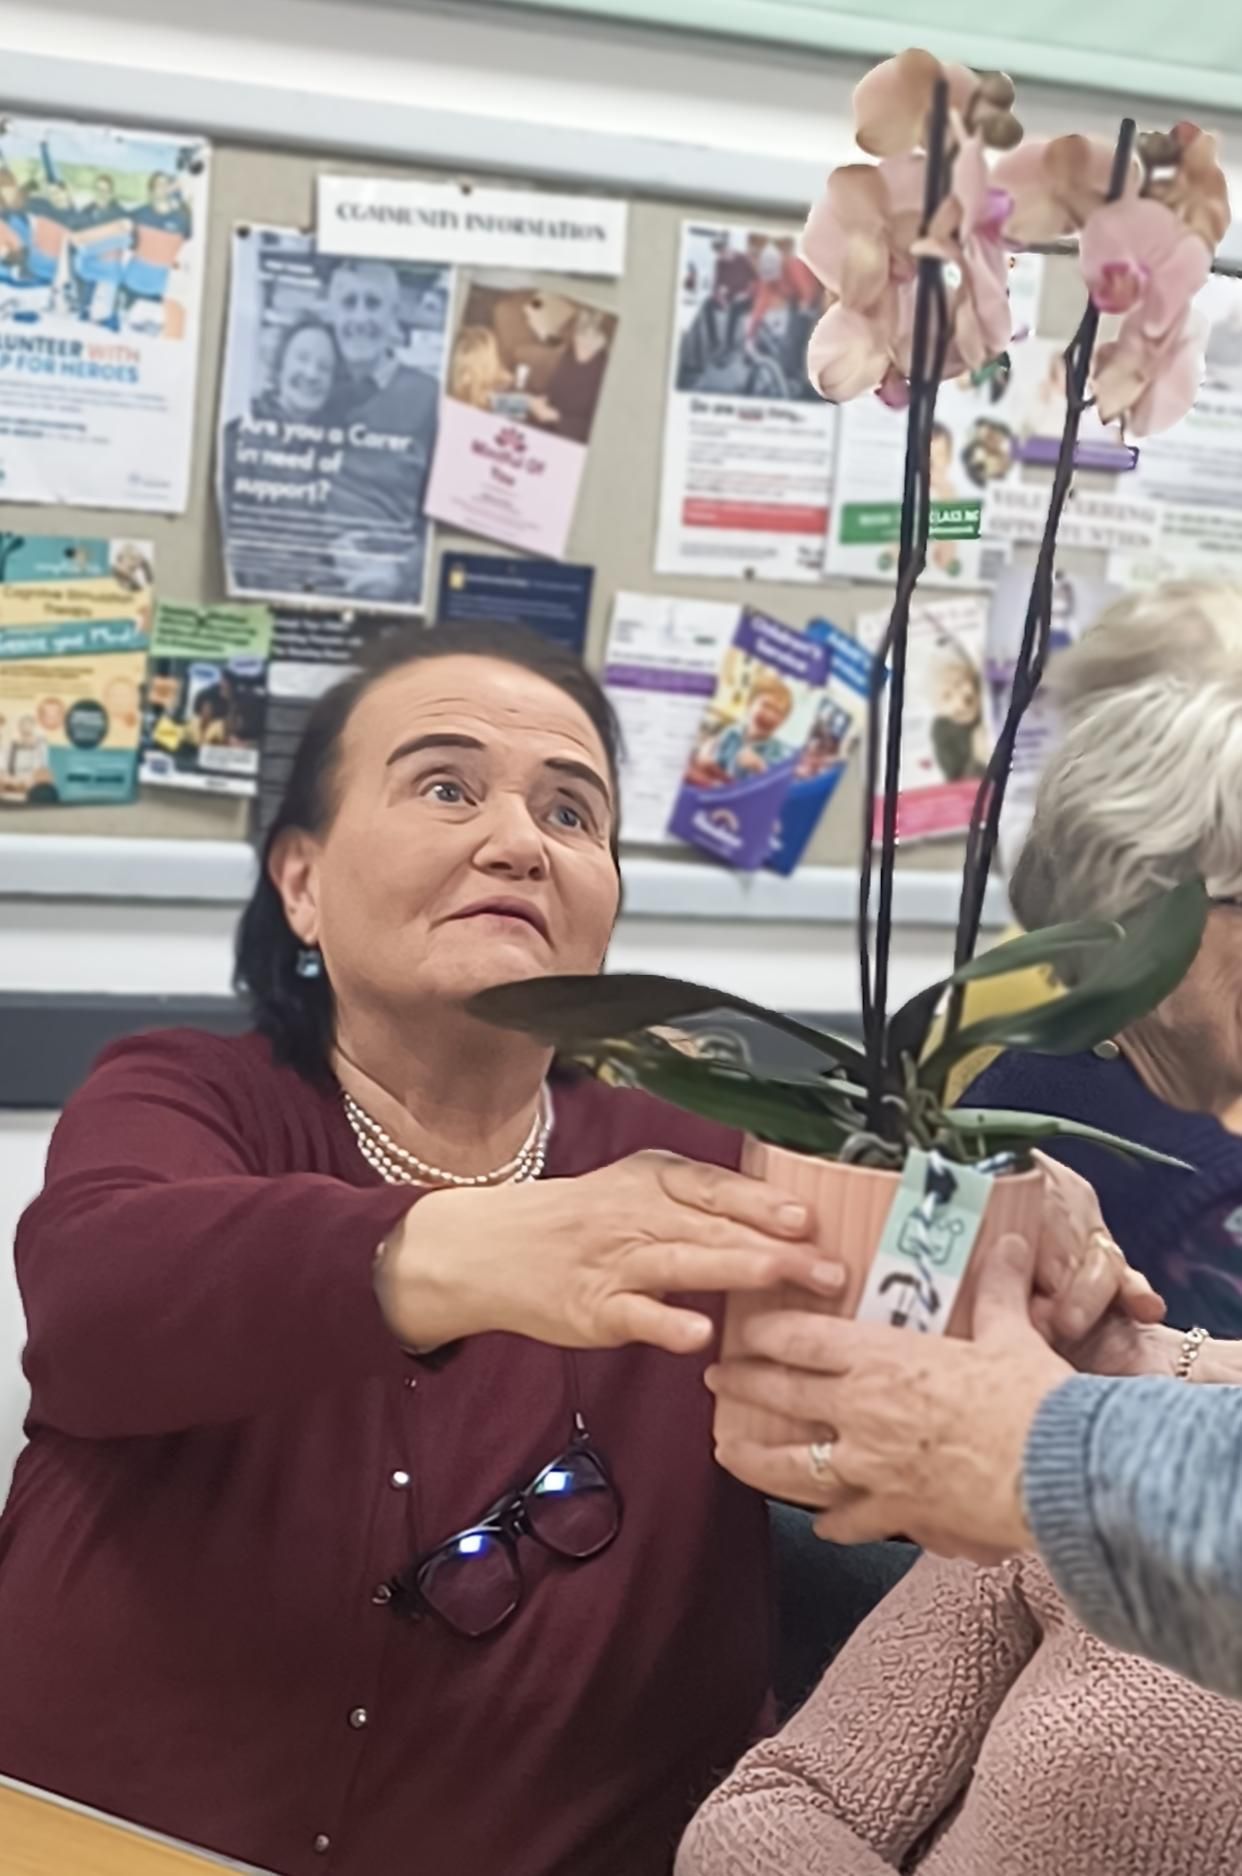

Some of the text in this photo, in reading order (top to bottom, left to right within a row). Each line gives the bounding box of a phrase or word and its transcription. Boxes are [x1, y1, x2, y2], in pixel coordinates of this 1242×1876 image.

[335, 203, 606, 243] COMMUNITY INFORMATION
[0, 333, 83, 356] UNTEER
[16, 354, 54, 376] FOR
[61, 361, 139, 385] HEROES
[238, 417, 278, 438] Are
[282, 423, 324, 444] you
[349, 423, 413, 452] Carer
[236, 441, 343, 473] in need of
[234, 477, 331, 505] support?
